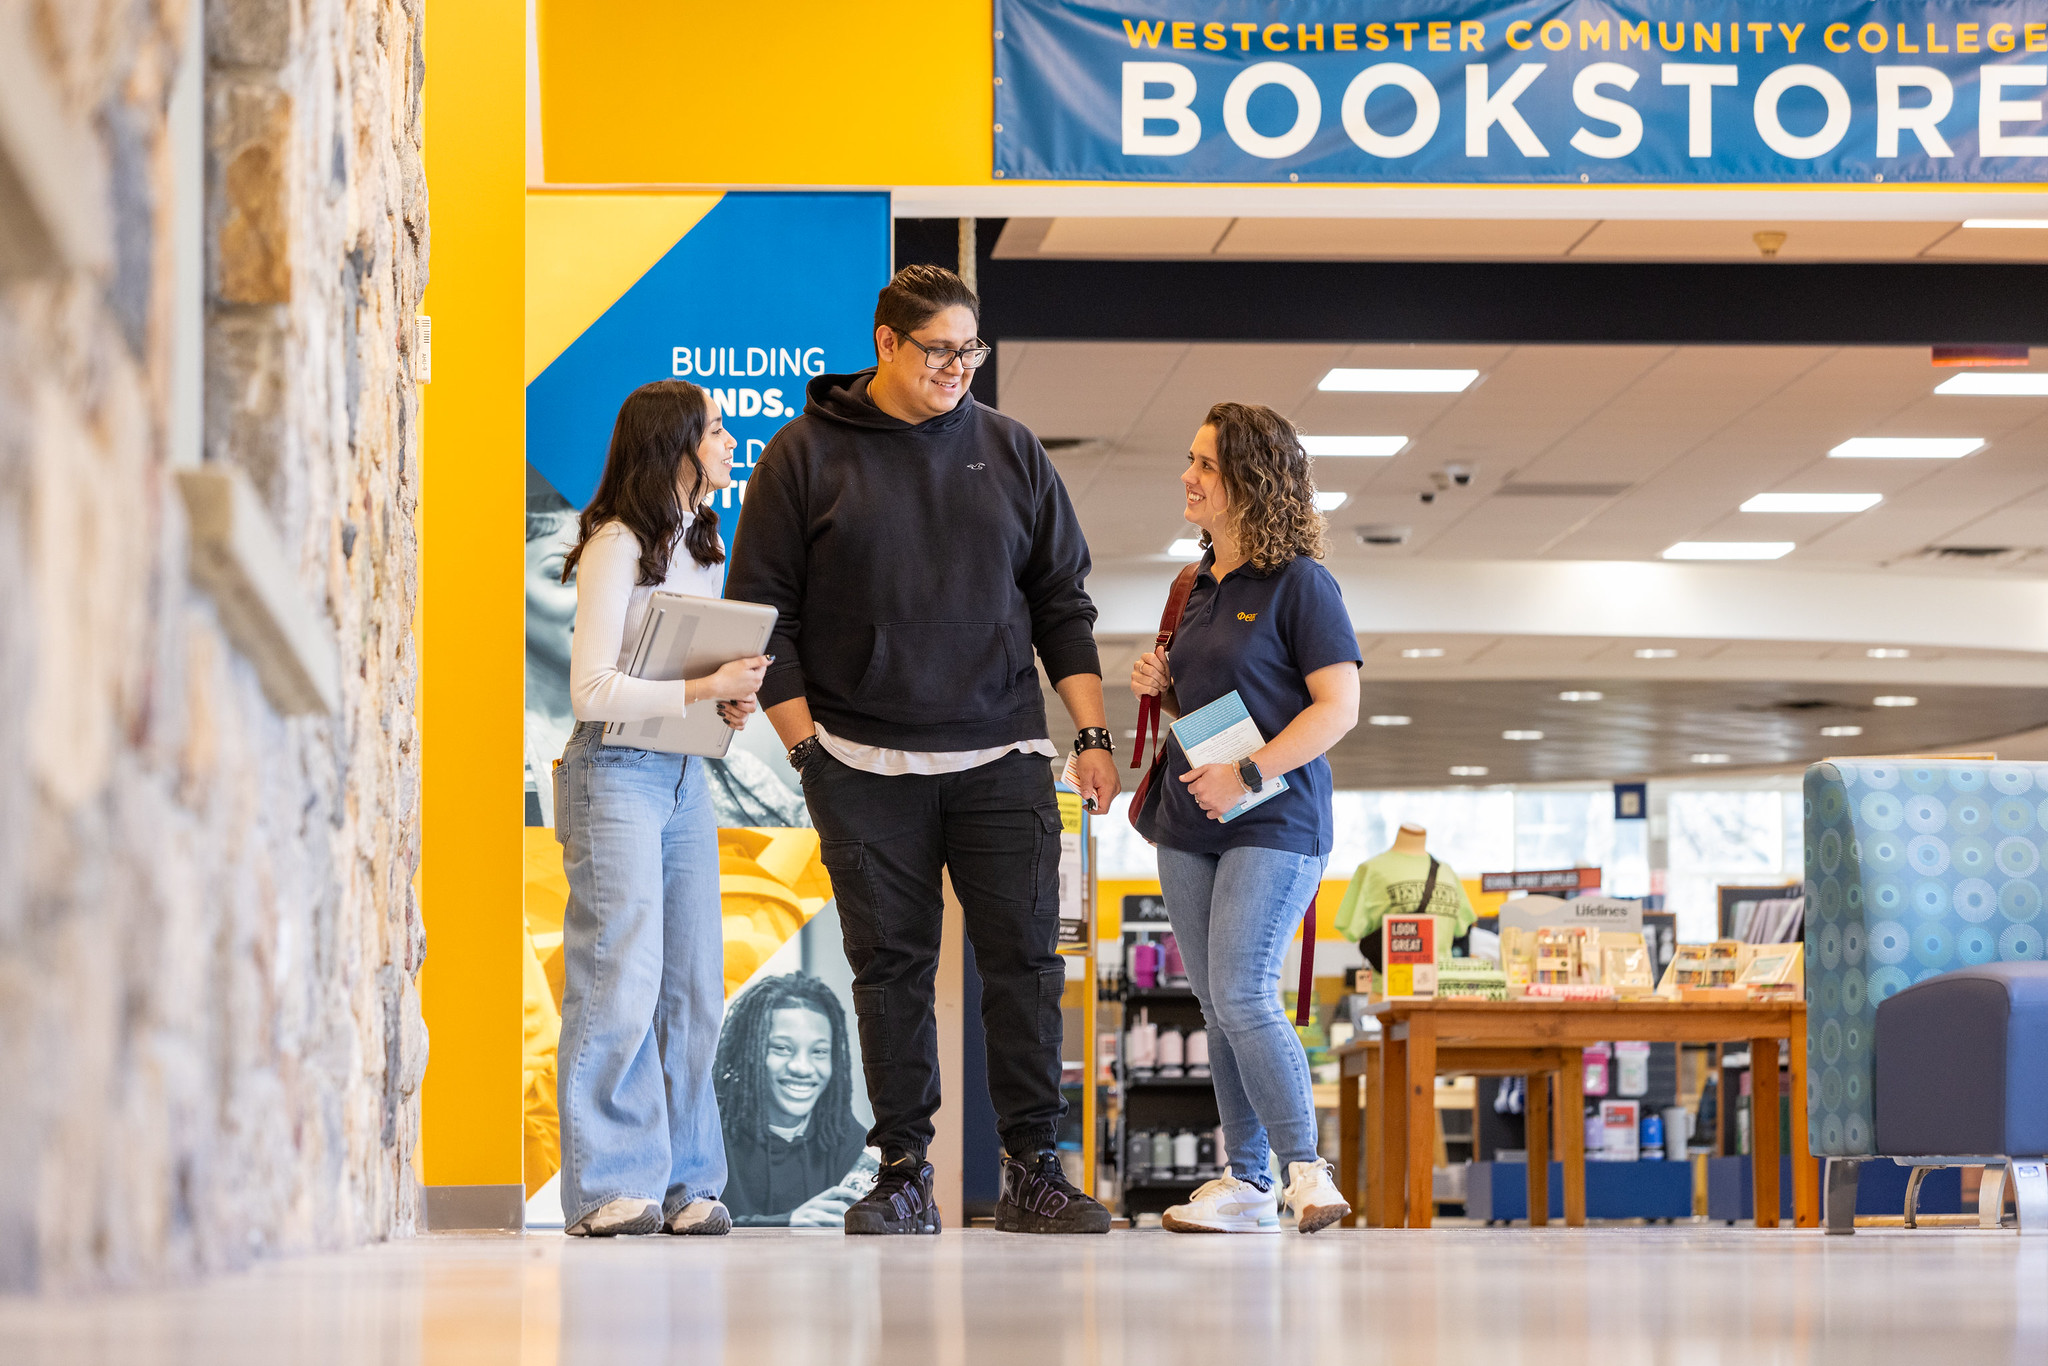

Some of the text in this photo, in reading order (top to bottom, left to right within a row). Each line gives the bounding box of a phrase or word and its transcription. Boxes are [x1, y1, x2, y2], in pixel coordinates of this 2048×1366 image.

[1122, 20, 2048, 53] WESTCHESTER COMMUNITY COLLEGE
[1122, 61, 2048, 158] BOOKSTORE
[672, 346, 826, 377] BUILDING
[1575, 903, 1628, 917] Lifelines
[1391, 922, 1418, 936] LOOK
[1391, 938, 1421, 952] GREAT
